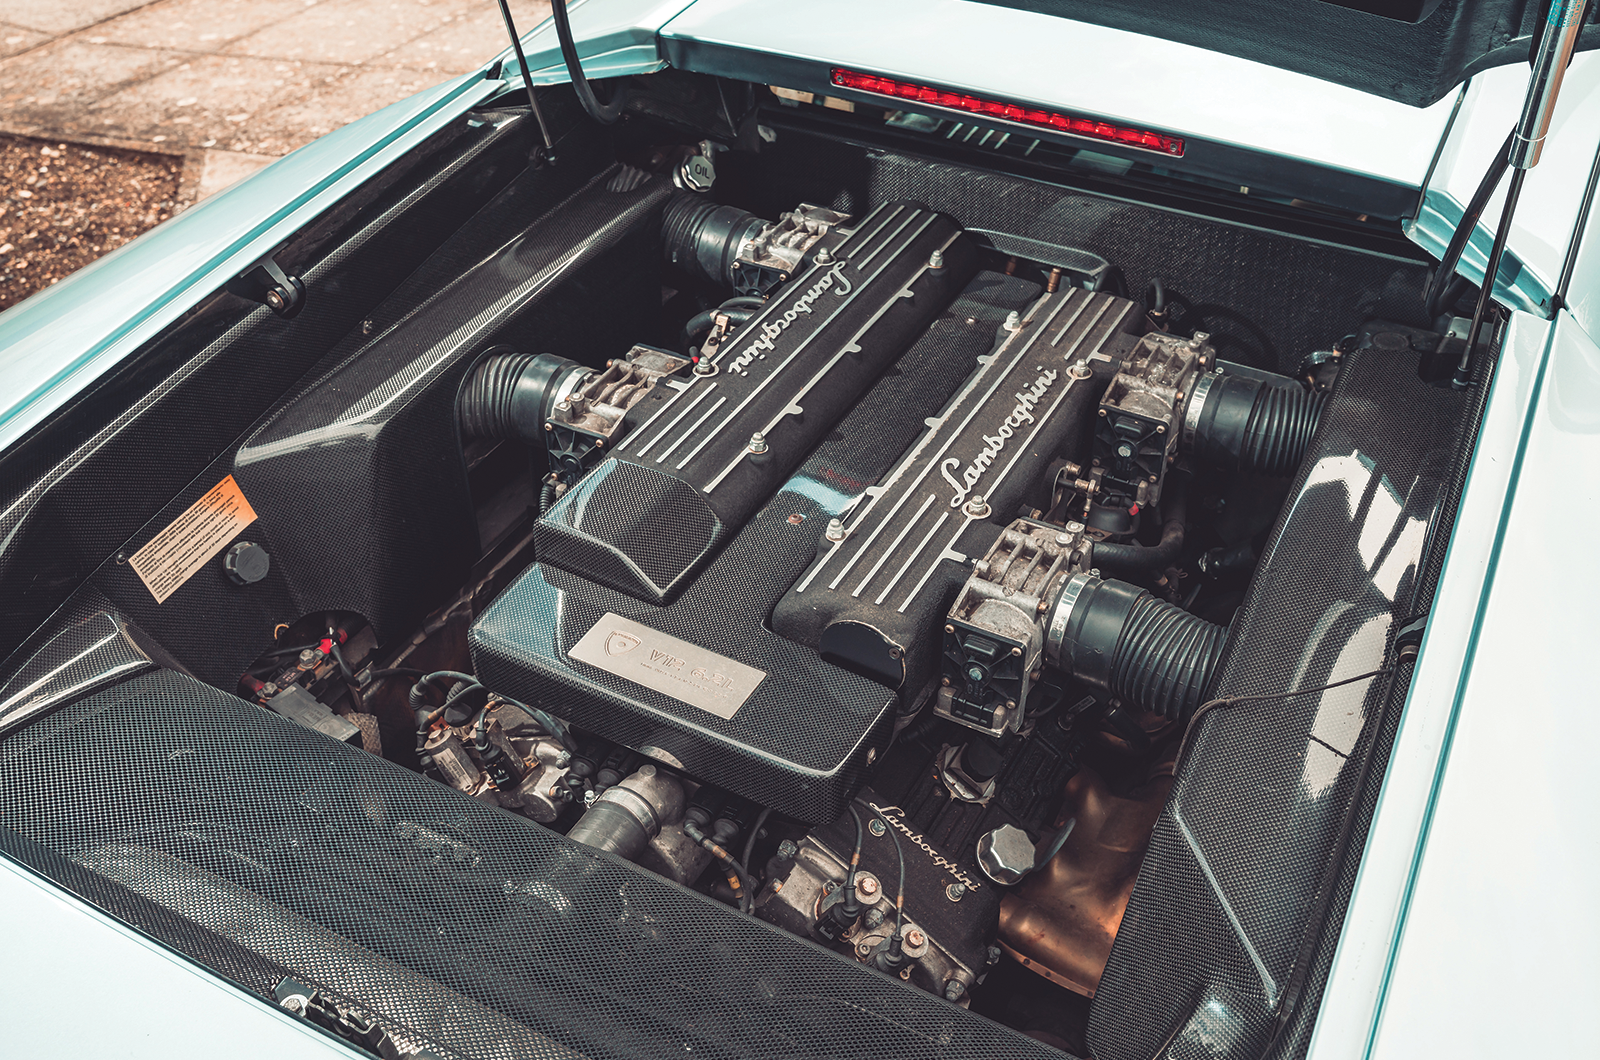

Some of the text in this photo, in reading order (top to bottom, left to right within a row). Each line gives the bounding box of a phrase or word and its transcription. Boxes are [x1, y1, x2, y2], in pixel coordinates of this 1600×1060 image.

[694, 163, 710, 180] OIL
[728, 261, 852, 377] Lamborghini
[940, 366, 1057, 508] Lamborghini
[649, 649, 686, 671] V12
[690, 667, 734, 692] 6.2L
[869, 802, 982, 892] Lamborghini
